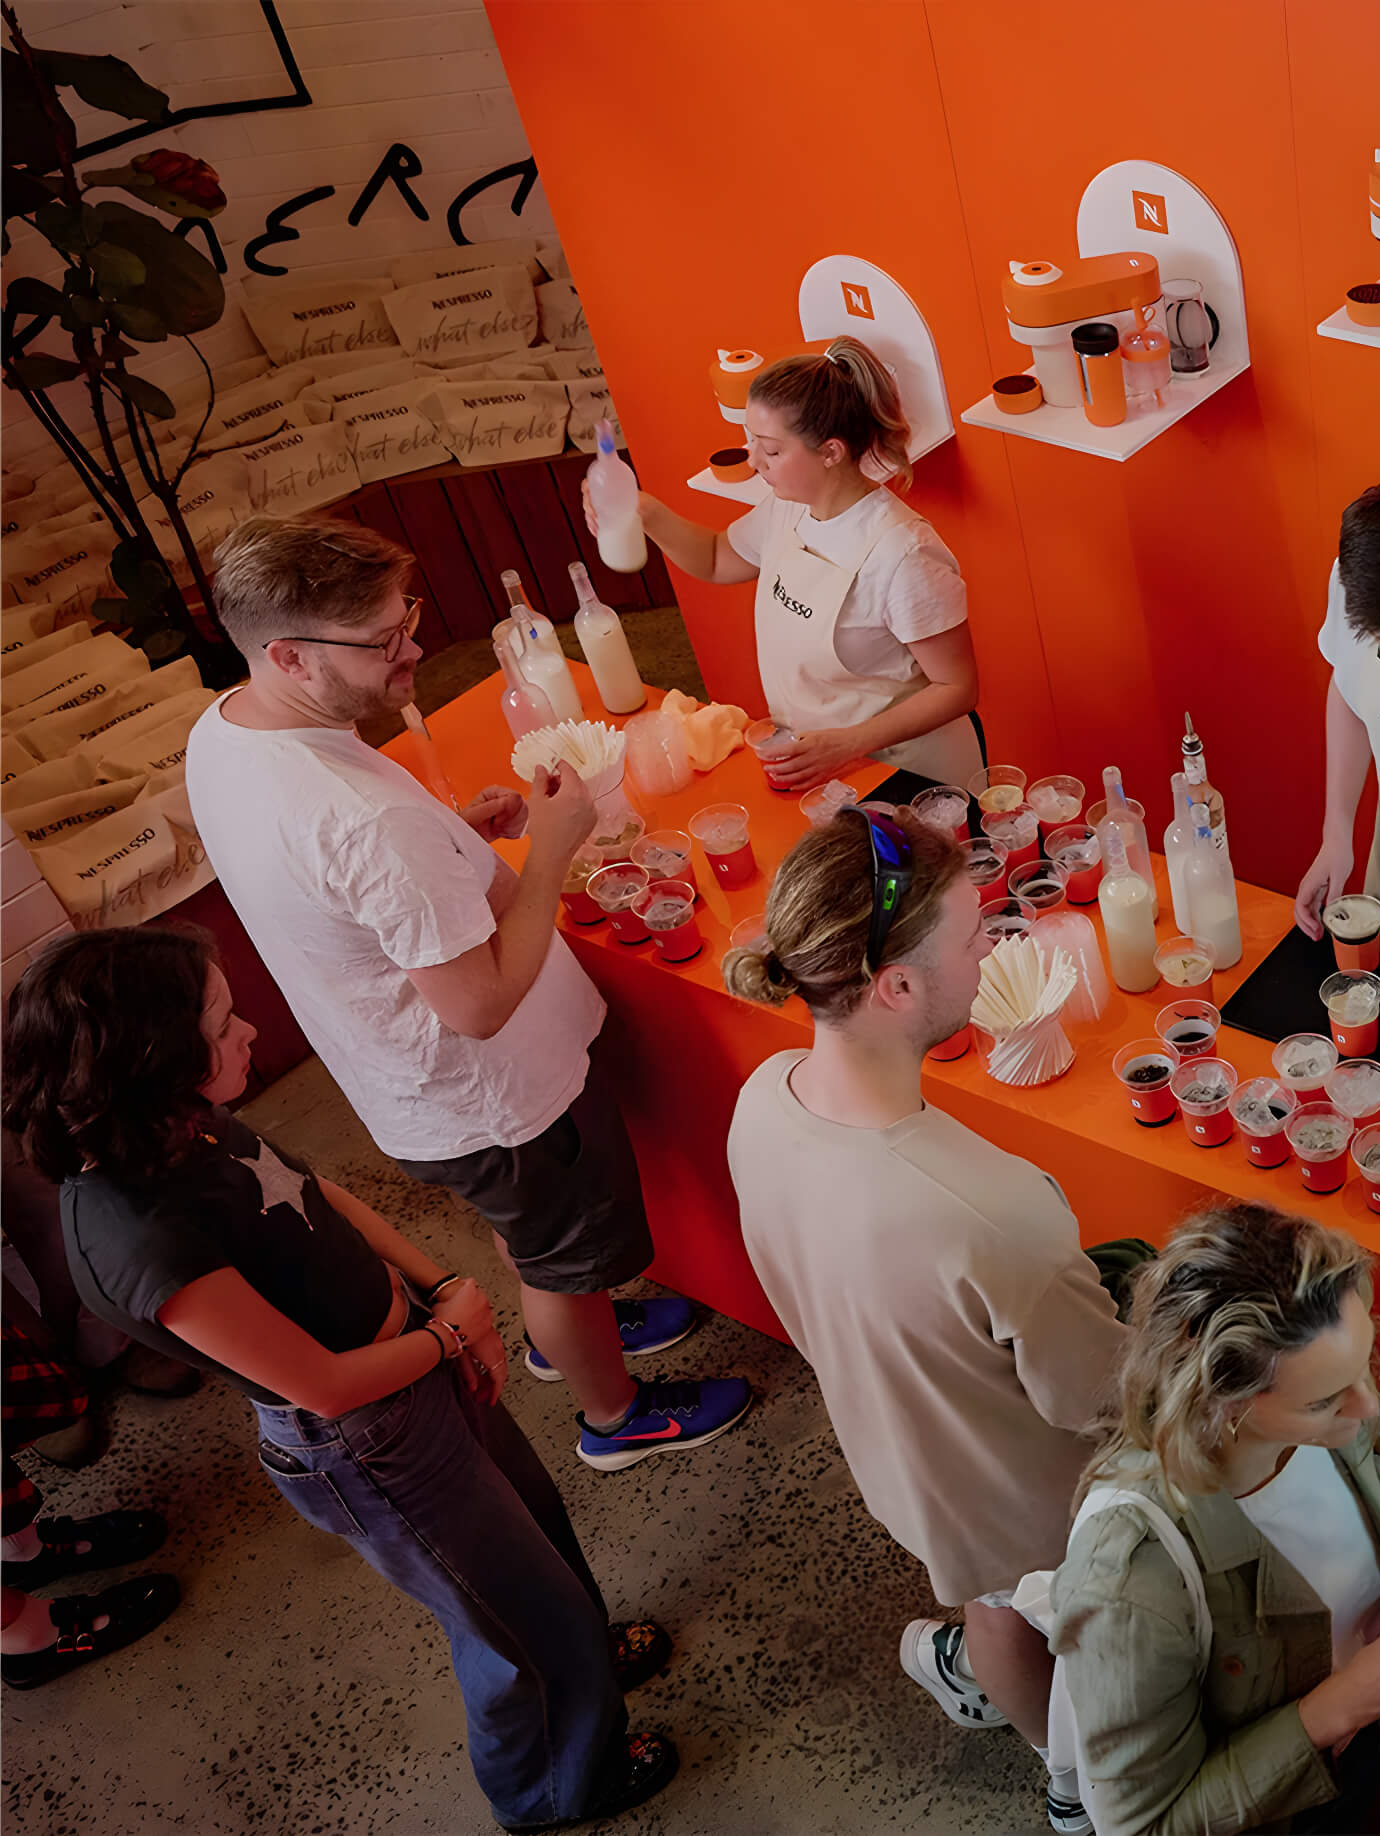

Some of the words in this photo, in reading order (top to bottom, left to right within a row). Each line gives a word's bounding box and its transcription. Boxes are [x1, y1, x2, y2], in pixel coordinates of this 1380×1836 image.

[292, 300, 356, 322] NESPRESSO
[22, 805, 116, 842] NESPRESSO
[75, 828, 156, 881] NESPRESSO
